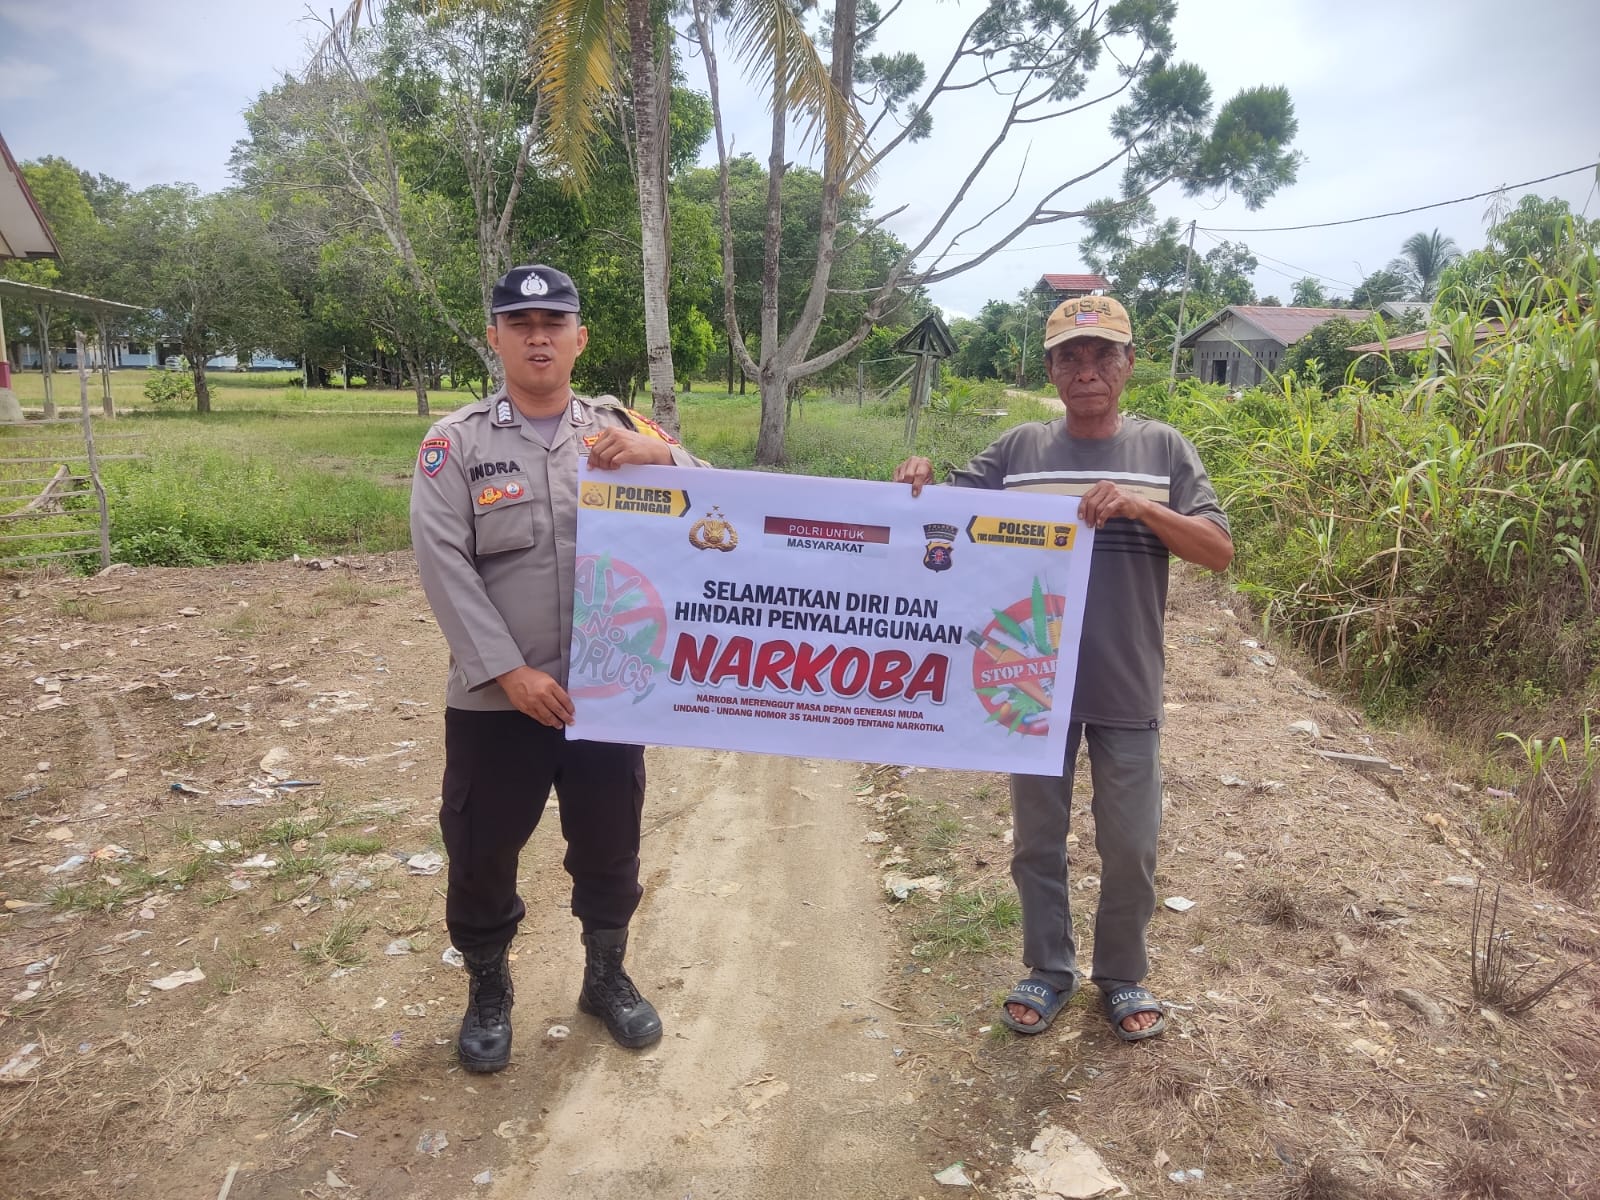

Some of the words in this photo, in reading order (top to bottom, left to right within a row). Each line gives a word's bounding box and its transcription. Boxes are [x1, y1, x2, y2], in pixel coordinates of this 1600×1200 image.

[1063, 299, 1112, 318] USA
[469, 461, 521, 481] INDRA
[615, 486, 672, 503] POLRES
[614, 500, 671, 514] KATINGAN
[789, 524, 823, 537] POLRI
[826, 527, 865, 540] UNTUK
[998, 522, 1046, 538] POLSEK
[787, 538, 865, 553] MASYARAKAT
[703, 580, 840, 610] SELAMATKAN
[846, 592, 889, 614] DIRI
[894, 597, 938, 619] DAN
[674, 601, 762, 627] HINDARI
[767, 609, 963, 645] PENYALAHGUNAAN
[569, 625, 654, 693] DRUGS
[669, 631, 949, 704] NARKOBA
[981, 664, 1024, 683] STOP
[696, 694, 738, 705] NARKOBA
[740, 697, 794, 710] MERENGGUT
[796, 702, 821, 712] MASA
[823, 704, 851, 714] DEPAN
[854, 707, 896, 718] GENERASI
[898, 710, 924, 720] MUDA
[673, 704, 710, 714] UNDANG
[716, 707, 753, 718] UNDANG
[754, 710, 787, 720] NOMOR
[789, 713, 801, 721] 35
[802, 714, 831, 724] TAHUN
[832, 717, 855, 727] 2009
[857, 718, 894, 728] TENTANG
[896, 721, 945, 733] NARKOTIKA
